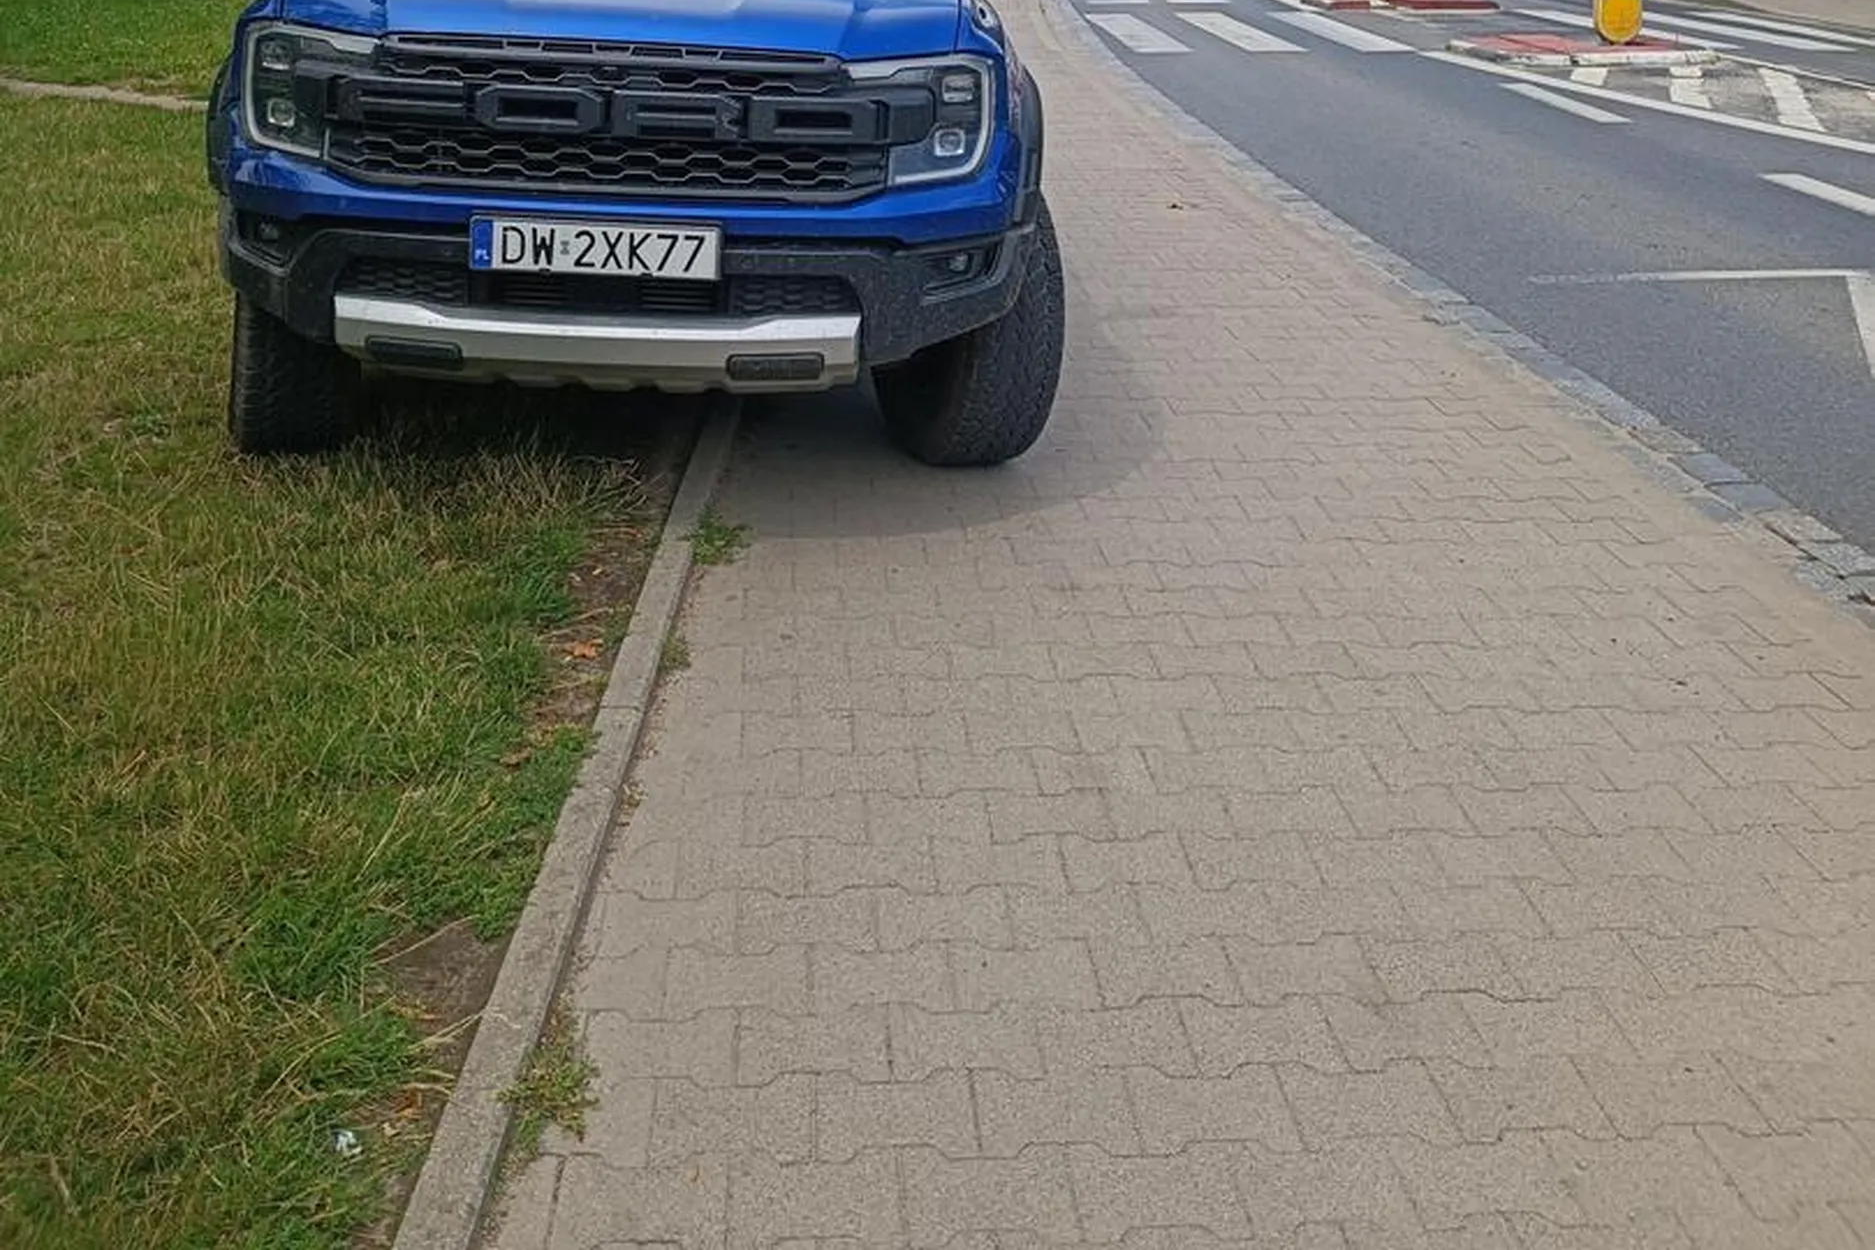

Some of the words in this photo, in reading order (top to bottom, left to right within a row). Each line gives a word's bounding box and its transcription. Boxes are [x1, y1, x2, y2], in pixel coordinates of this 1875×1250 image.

[337, 77, 878, 143] FORD
[501, 225, 556, 266] DW
[573, 229, 706, 273] 2XK77
